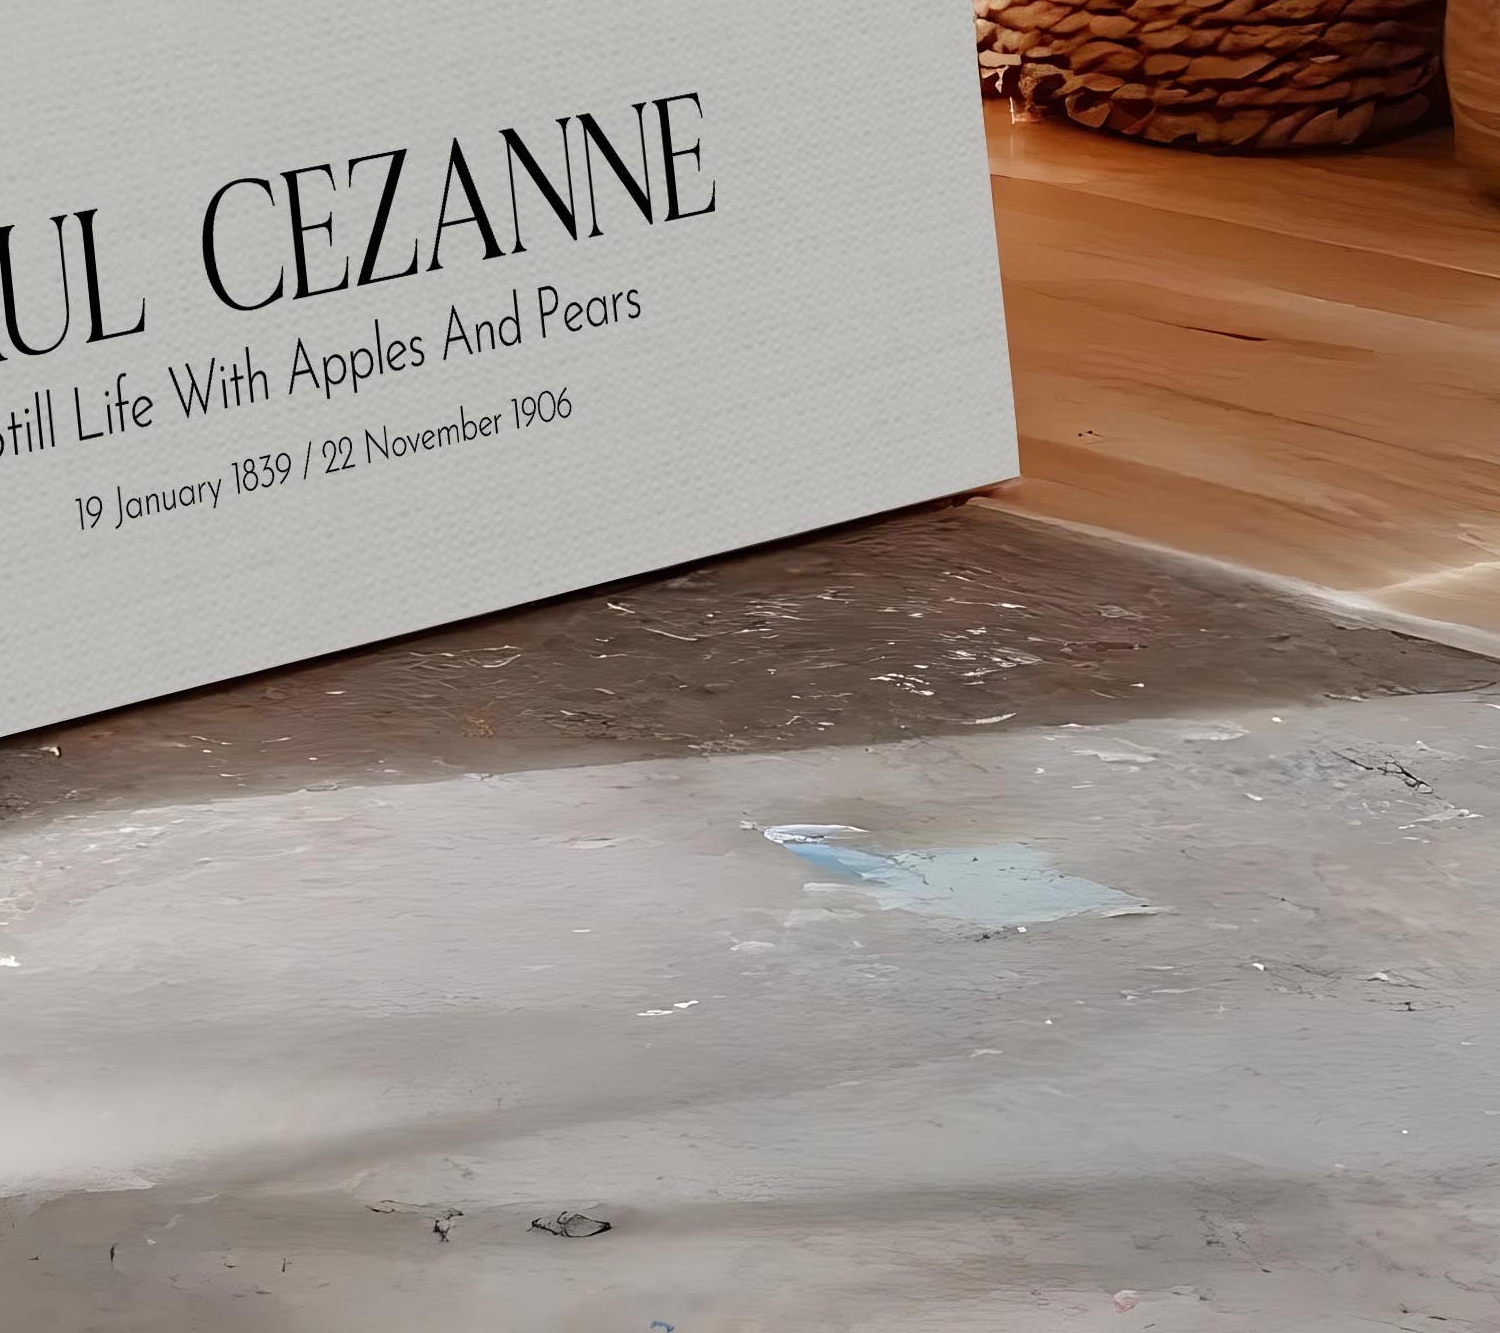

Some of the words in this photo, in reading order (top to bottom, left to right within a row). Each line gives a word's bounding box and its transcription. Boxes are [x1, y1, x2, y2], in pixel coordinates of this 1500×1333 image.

[202, 92, 716, 312] CEZANNE
[73, 373, 154, 442] Life
[167, 346, 270, 419] With
[288, 318, 426, 400] Apples
[442, 288, 522, 361] And
[537, 285, 642, 339] Pears
[74, 495, 103, 531] 19
[114, 478, 222, 530] January
[231, 452, 292, 495] 1839
[303, 440, 312, 481] /
[321, 436, 356, 475] 22
[364, 404, 502, 464] November
[510, 386, 573, 430] 1906
